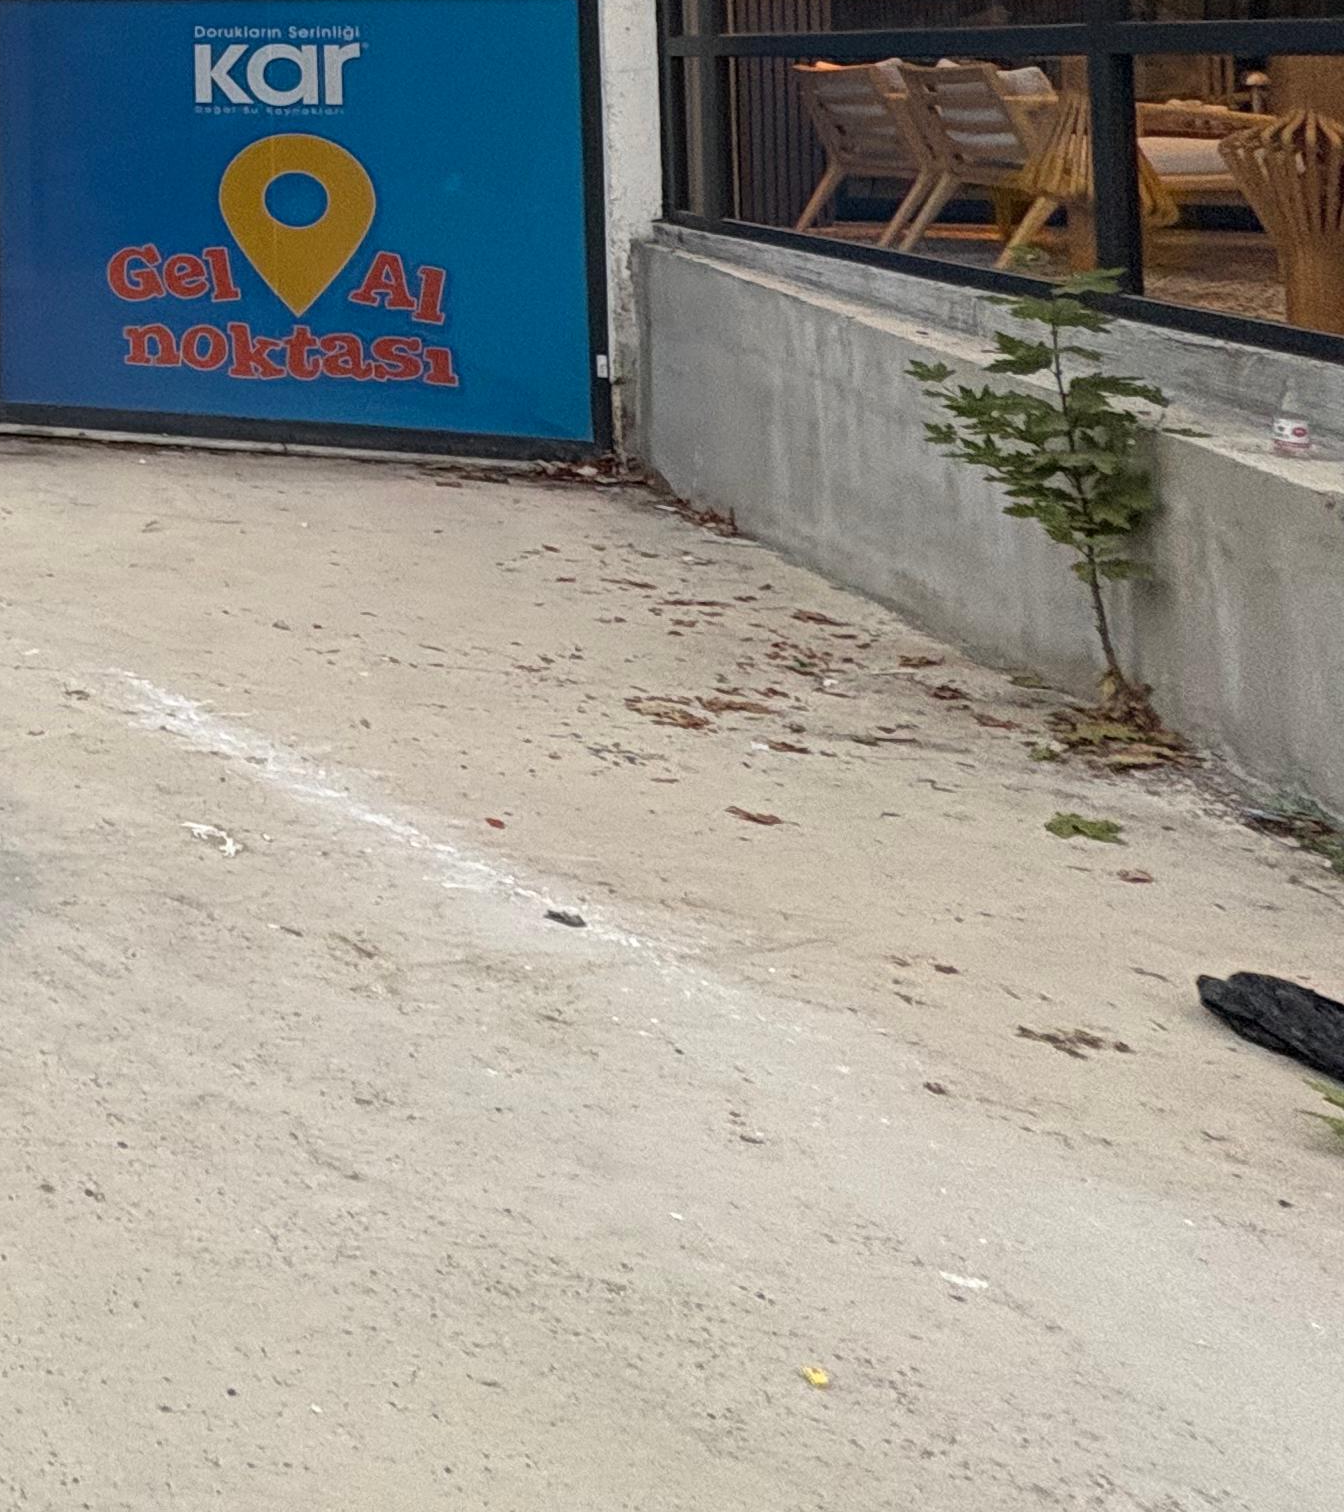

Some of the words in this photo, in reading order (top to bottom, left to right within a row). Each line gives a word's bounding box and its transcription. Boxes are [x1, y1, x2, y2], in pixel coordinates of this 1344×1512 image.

[194, 26, 282, 38] Dorukların
[288, 25, 360, 41] Serinliği
[194, 42, 361, 106] kar
[107, 243, 242, 302] Gel
[348, 251, 446, 326] Al
[122, 322, 459, 387] noktası
